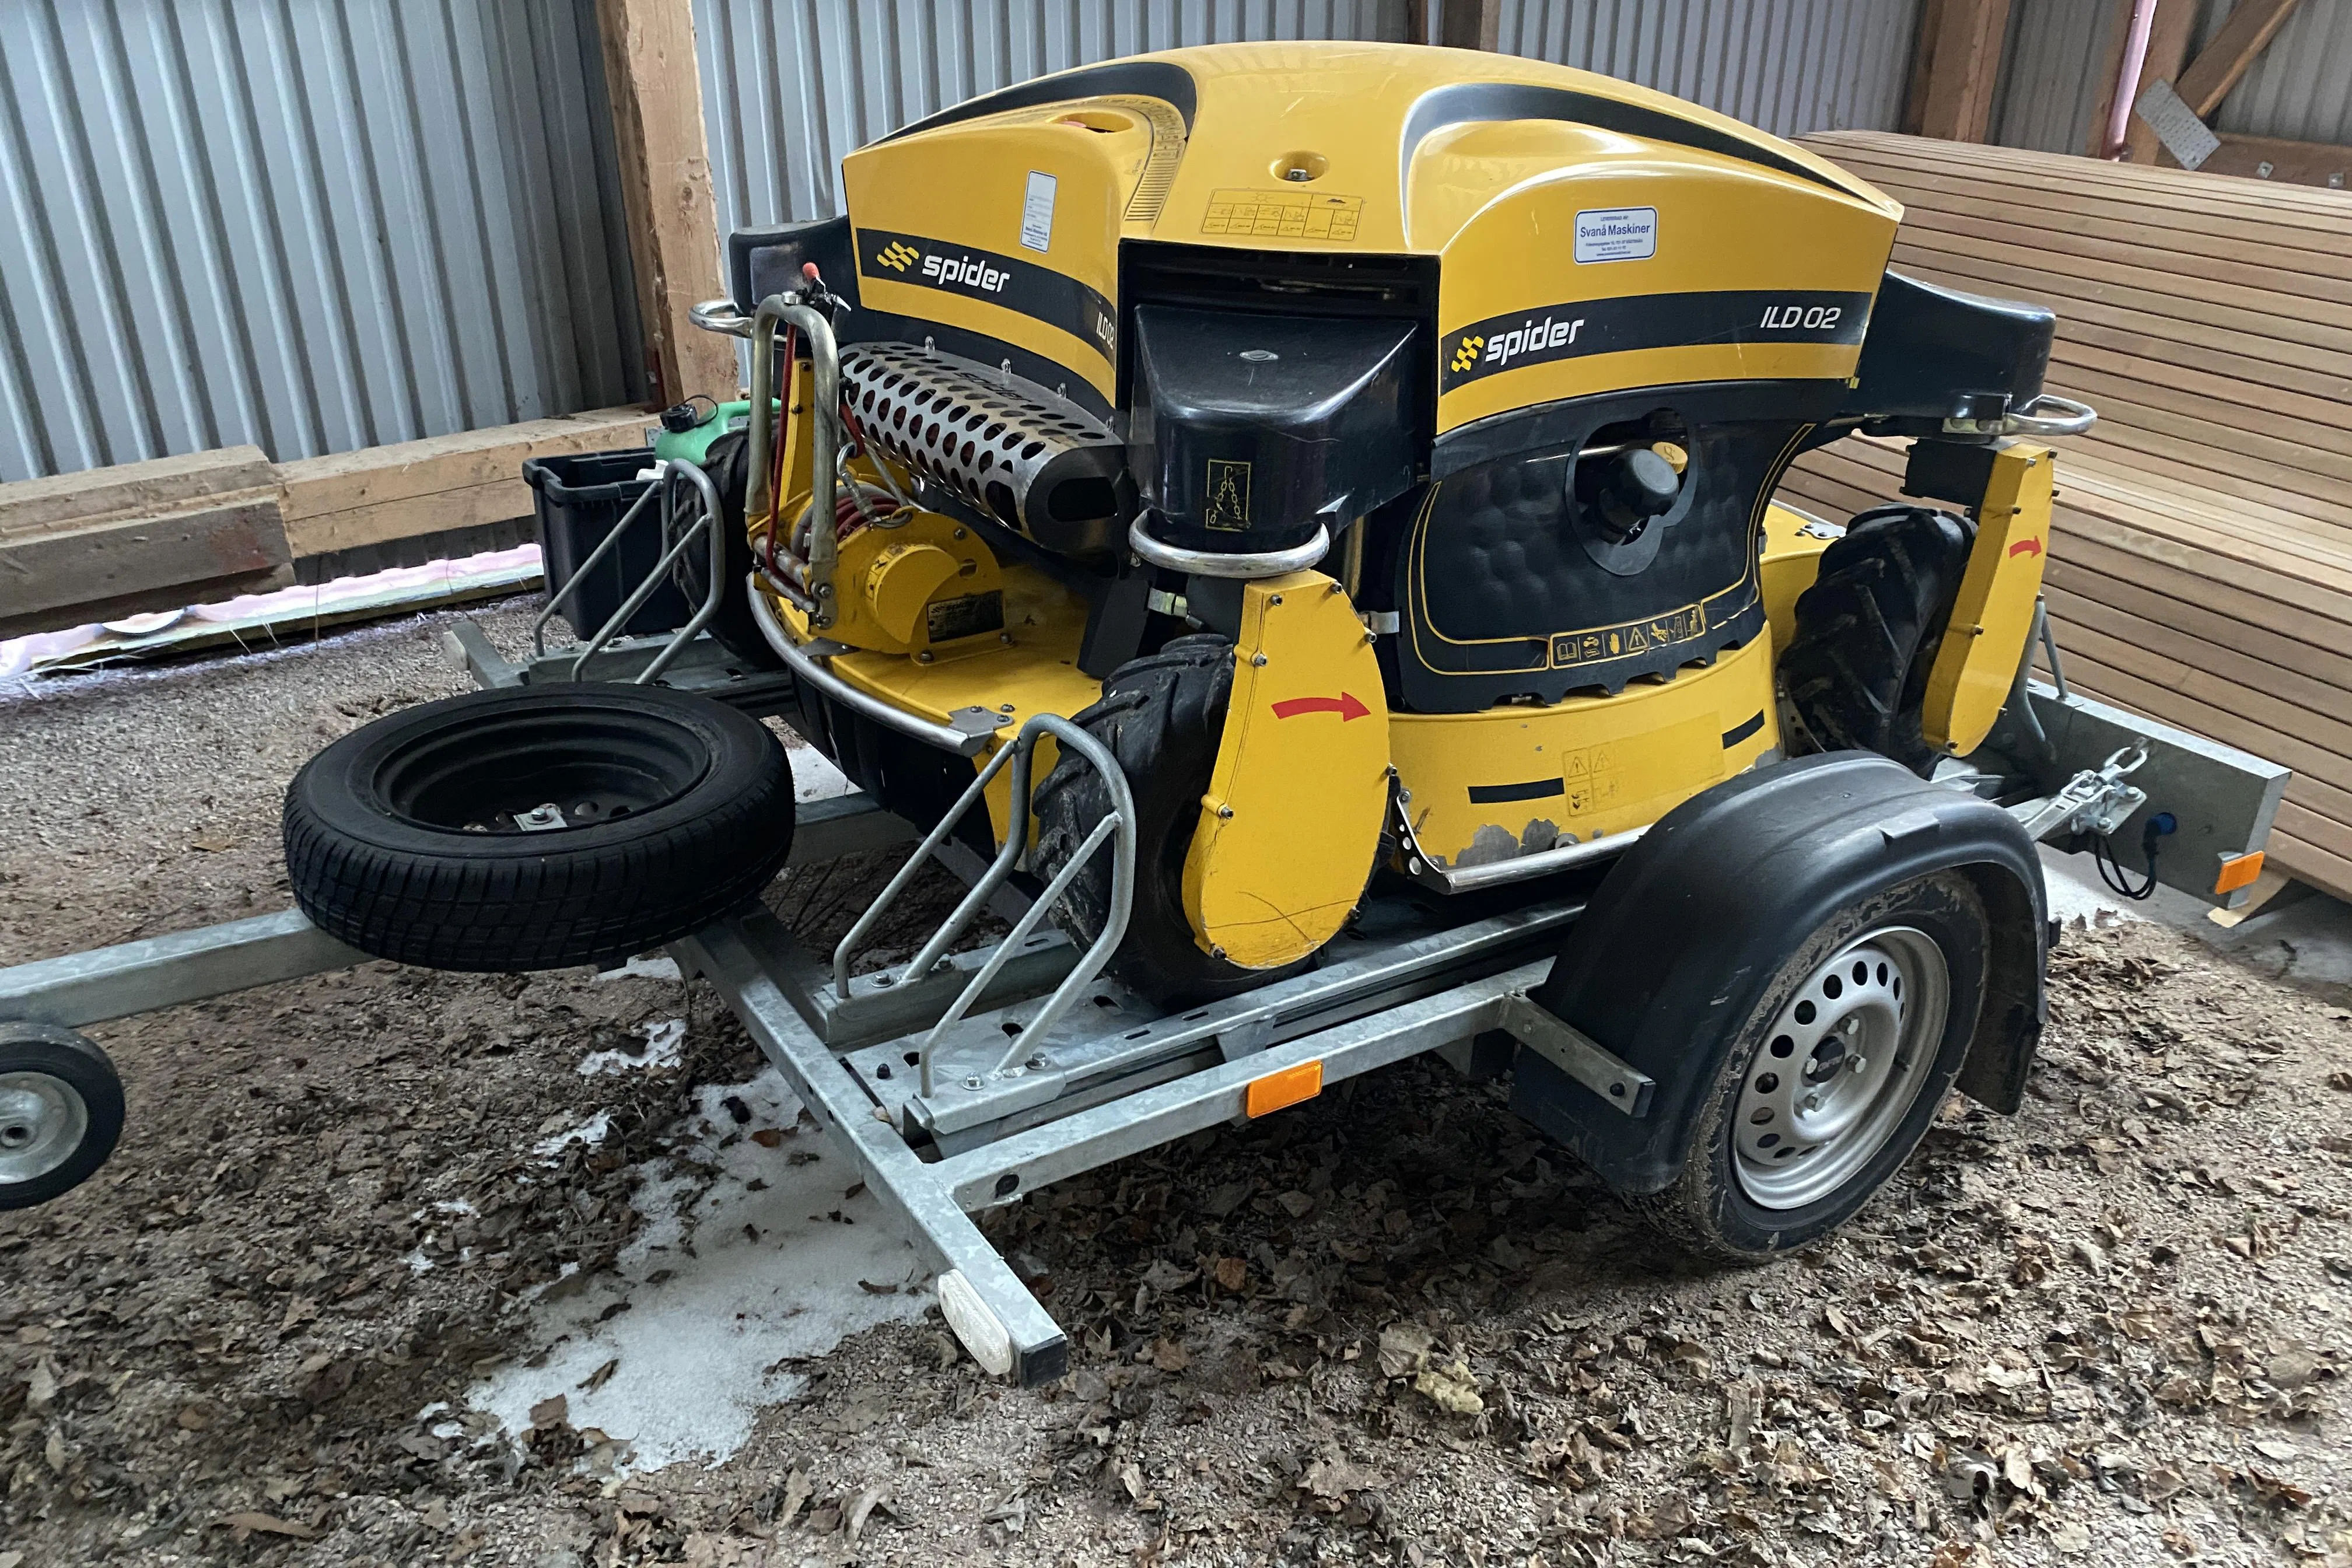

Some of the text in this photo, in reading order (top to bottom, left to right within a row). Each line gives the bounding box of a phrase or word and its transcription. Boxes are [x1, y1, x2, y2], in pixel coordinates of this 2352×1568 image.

[1580, 223, 1650, 237] Svanå Maskiner
[922, 255, 1010, 292] spider
[1097, 312, 1108, 340] ILD
[1760, 306, 1841, 328] ILD 02
[1485, 316, 1584, 366] spider
